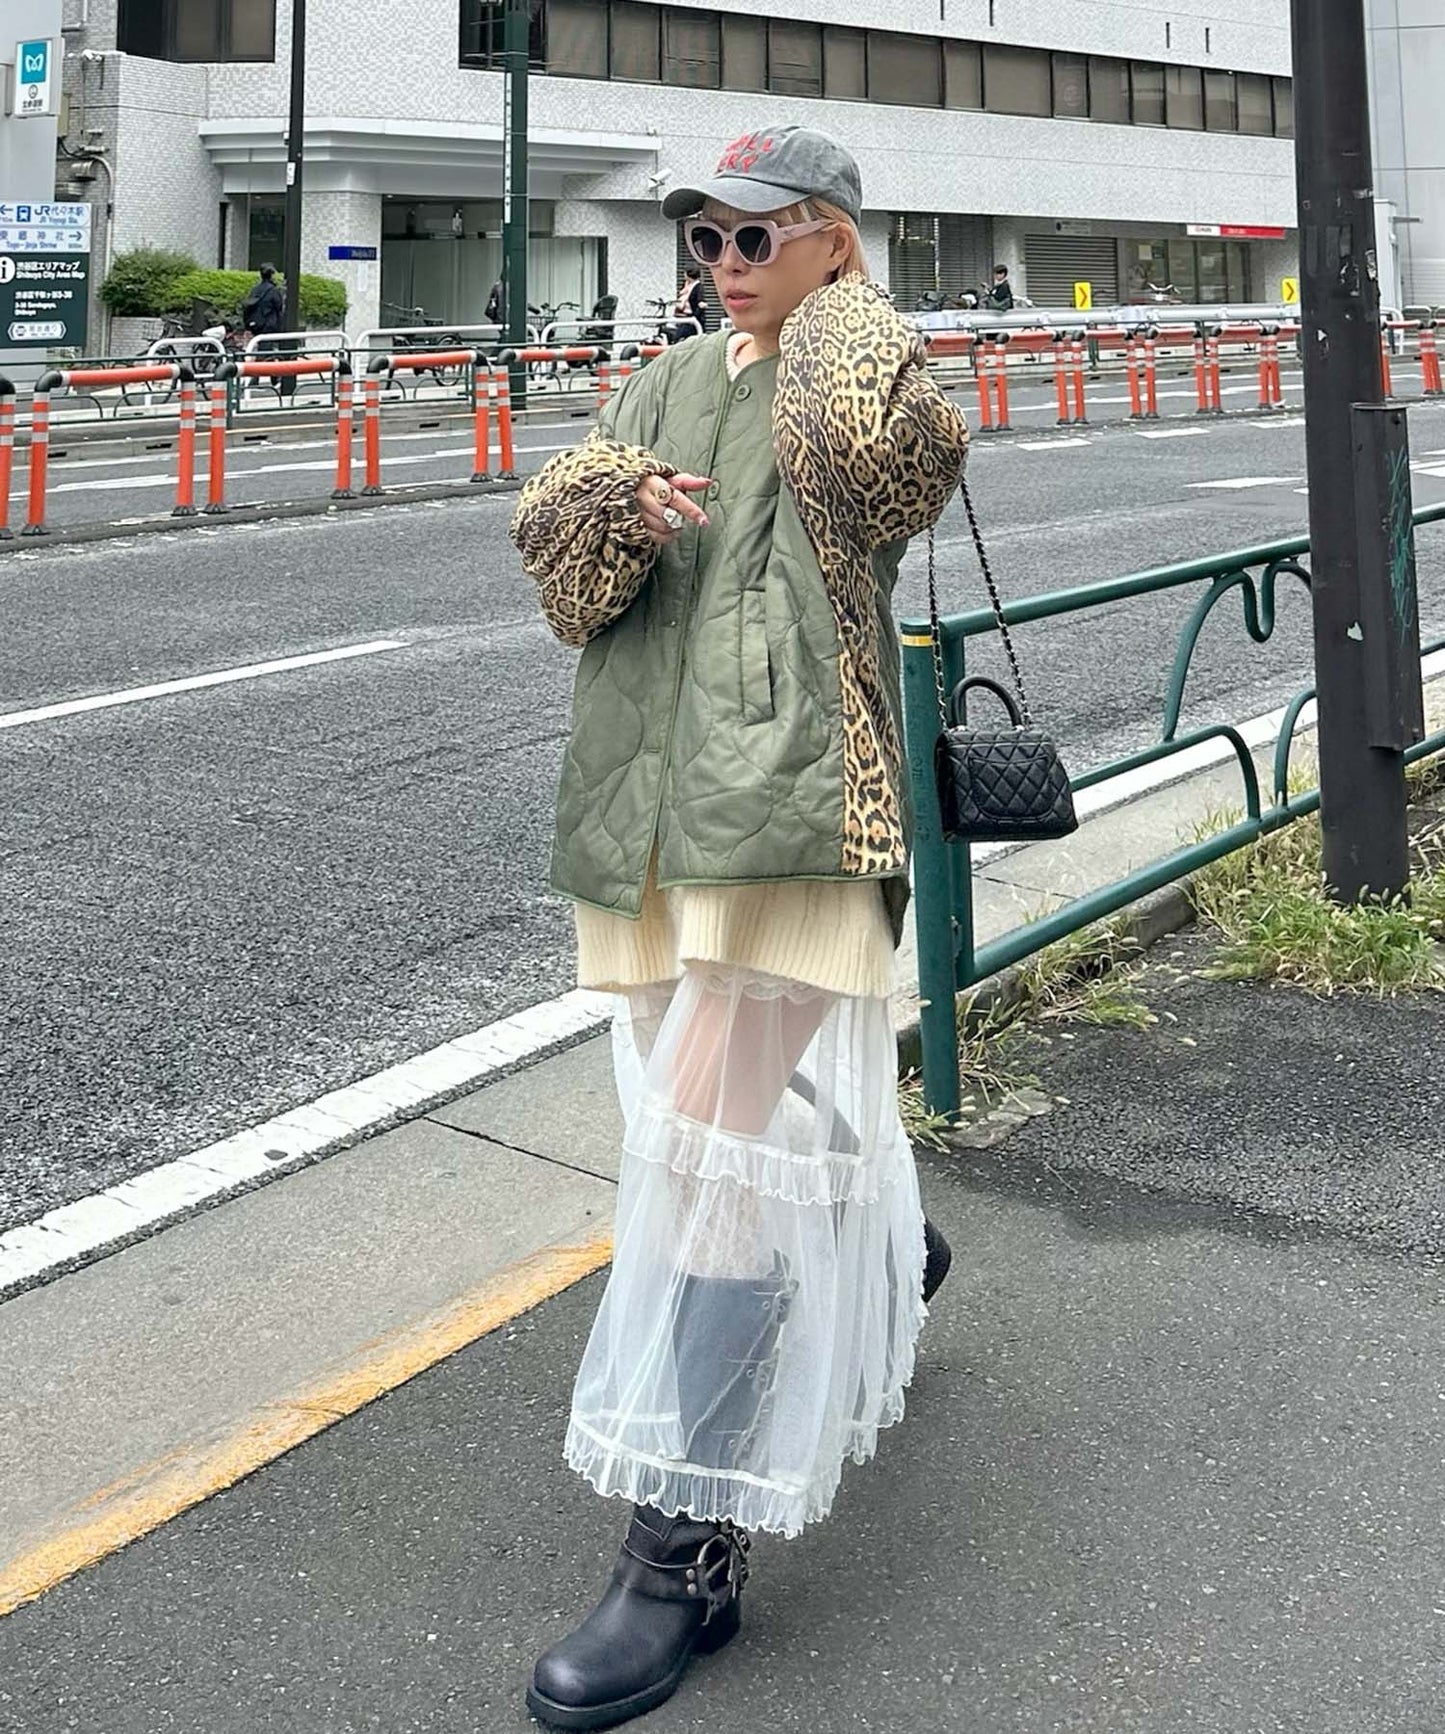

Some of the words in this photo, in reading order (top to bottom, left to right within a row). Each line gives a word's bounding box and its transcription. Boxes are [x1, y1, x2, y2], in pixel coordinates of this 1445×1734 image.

[16, 261, 80, 271] 渋谷区エリアマップ
[16, 271, 42, 280] Shibuya
[42, 271, 56, 280] City
[56, 271, 71, 279] Area
[71, 271, 86, 280] Map
